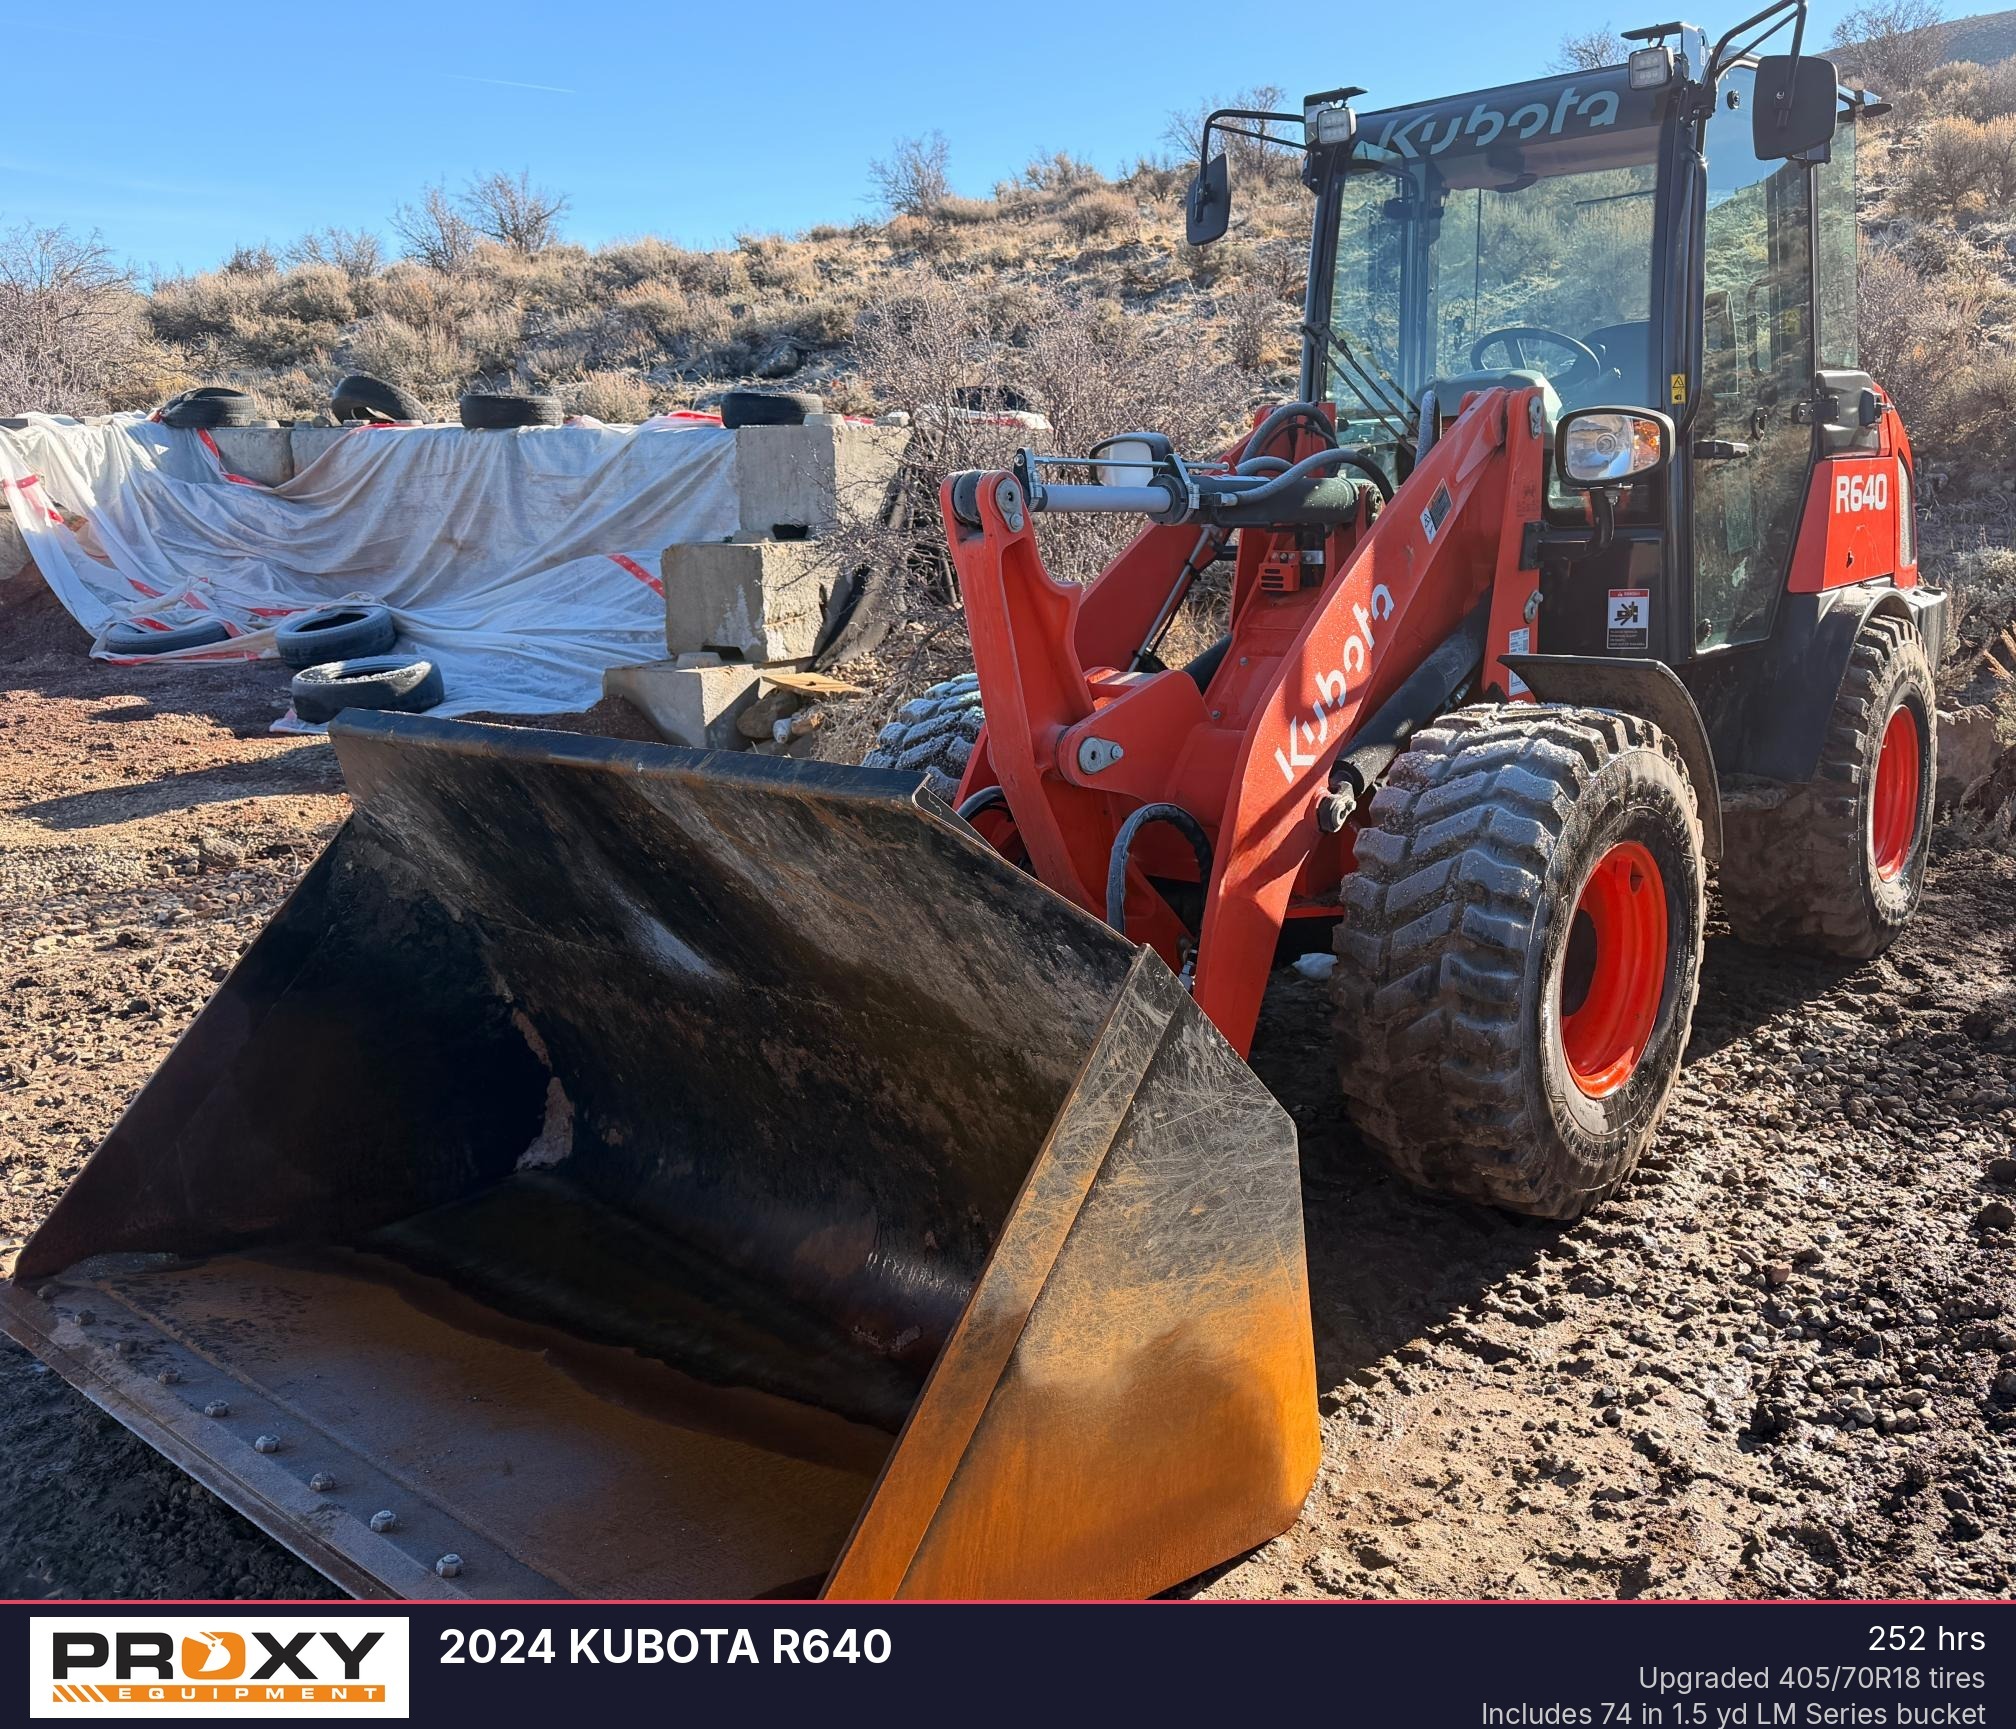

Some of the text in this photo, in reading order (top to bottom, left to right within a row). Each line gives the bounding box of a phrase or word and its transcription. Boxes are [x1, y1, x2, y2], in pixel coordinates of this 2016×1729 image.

[1378, 87, 1620, 159] Kubota
[1835, 473, 1888, 514] R640
[1274, 583, 1395, 784] Kubota
